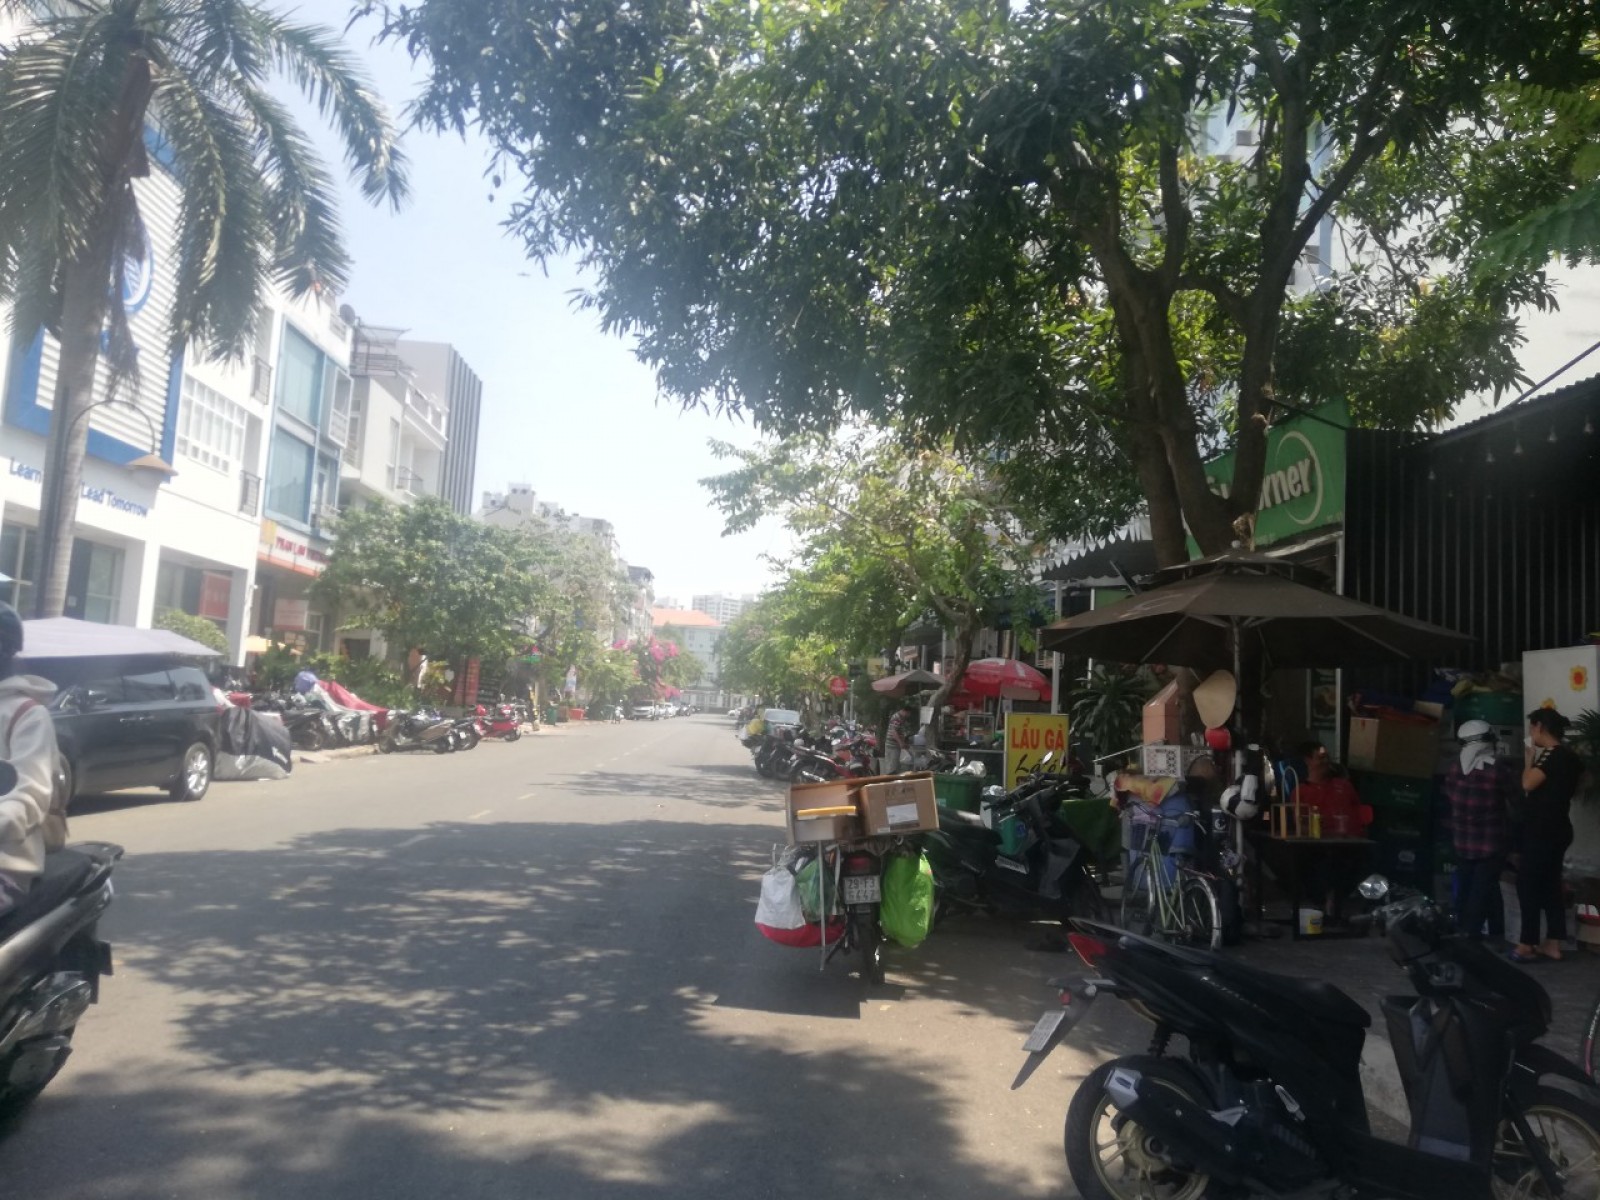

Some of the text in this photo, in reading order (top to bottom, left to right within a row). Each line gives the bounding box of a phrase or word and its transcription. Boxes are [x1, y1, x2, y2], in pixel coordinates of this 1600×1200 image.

[9, 457, 42, 483] Learn
[1258, 458, 1311, 510] rner
[80, 481, 149, 517] Lead Tomorrow
[1010, 717, 1065, 751] LẨU GÀ
